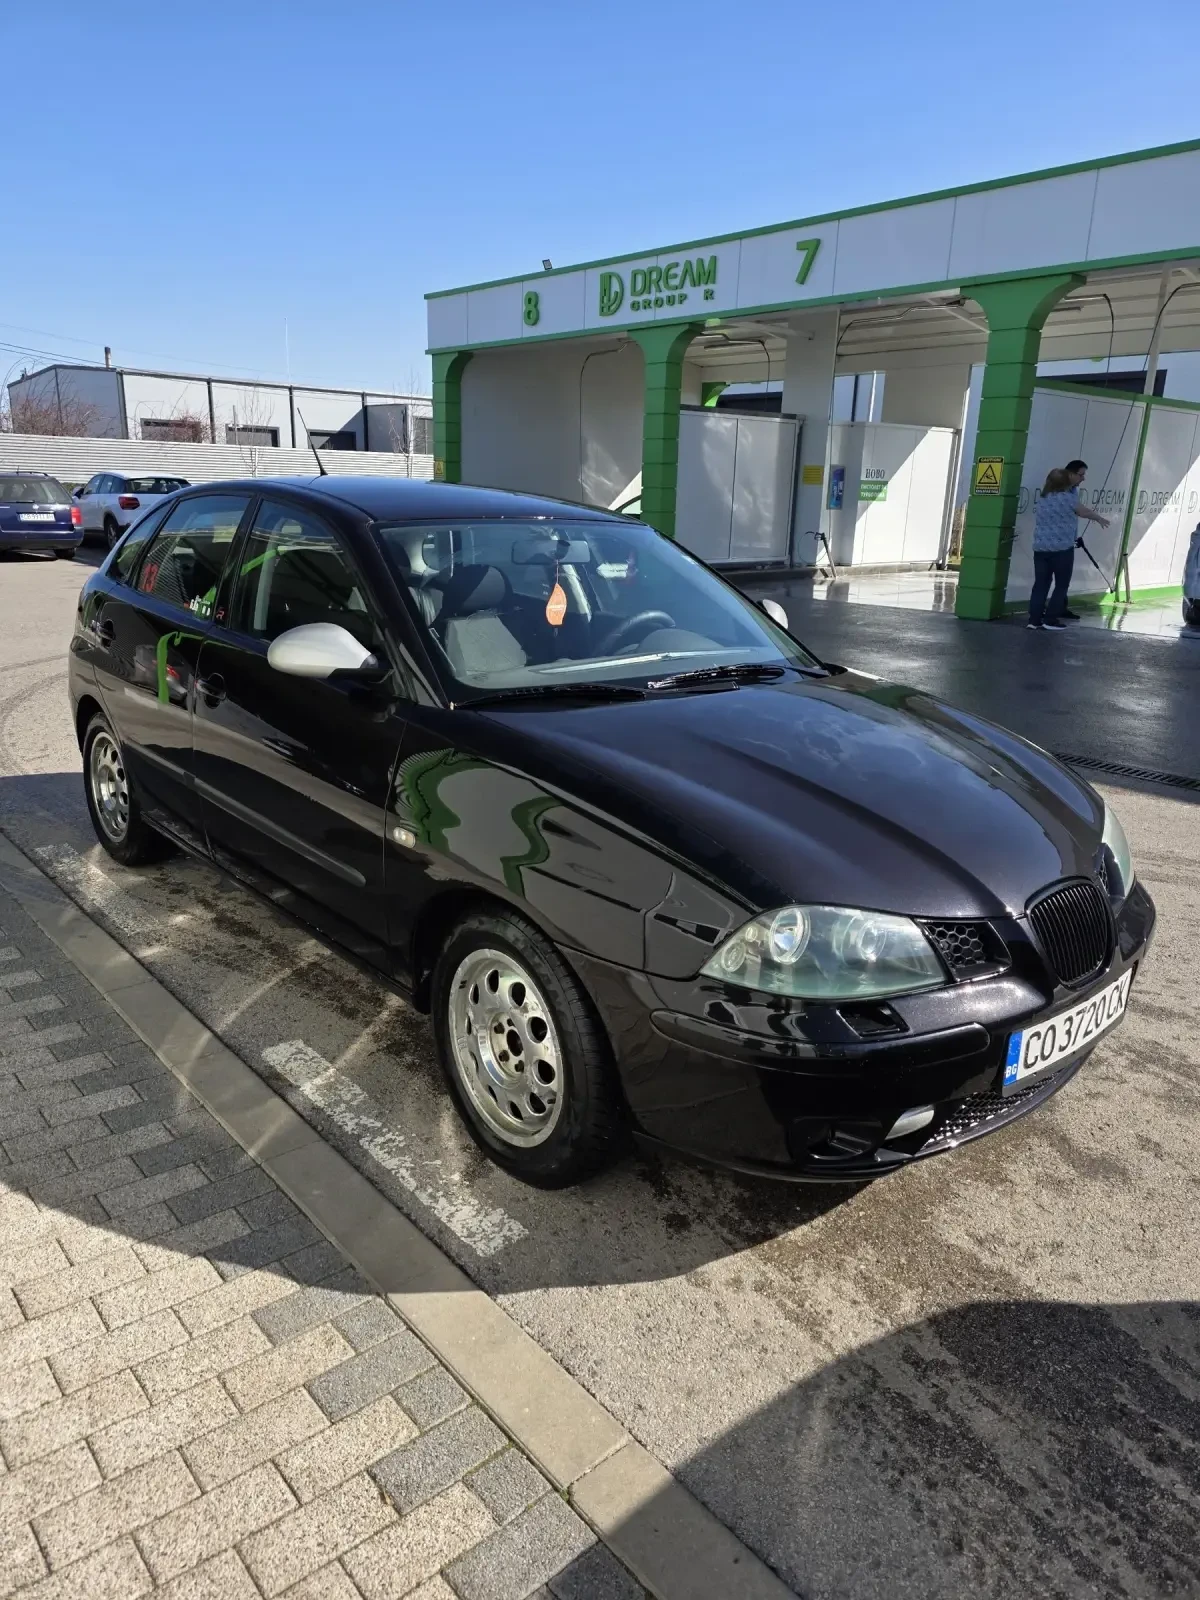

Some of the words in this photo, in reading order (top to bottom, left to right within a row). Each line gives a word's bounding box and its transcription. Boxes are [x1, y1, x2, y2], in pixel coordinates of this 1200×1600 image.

[630, 255, 717, 297] DREAM
[796, 238, 821, 285] 7
[523, 291, 540, 326] 8
[630, 293, 687, 312] GROUP
[703, 289, 715, 301] R
[1092, 489, 1125, 505] DREAM
[1058, 994, 1106, 1053] 3720
[1005, 1063, 1019, 1079] BG
